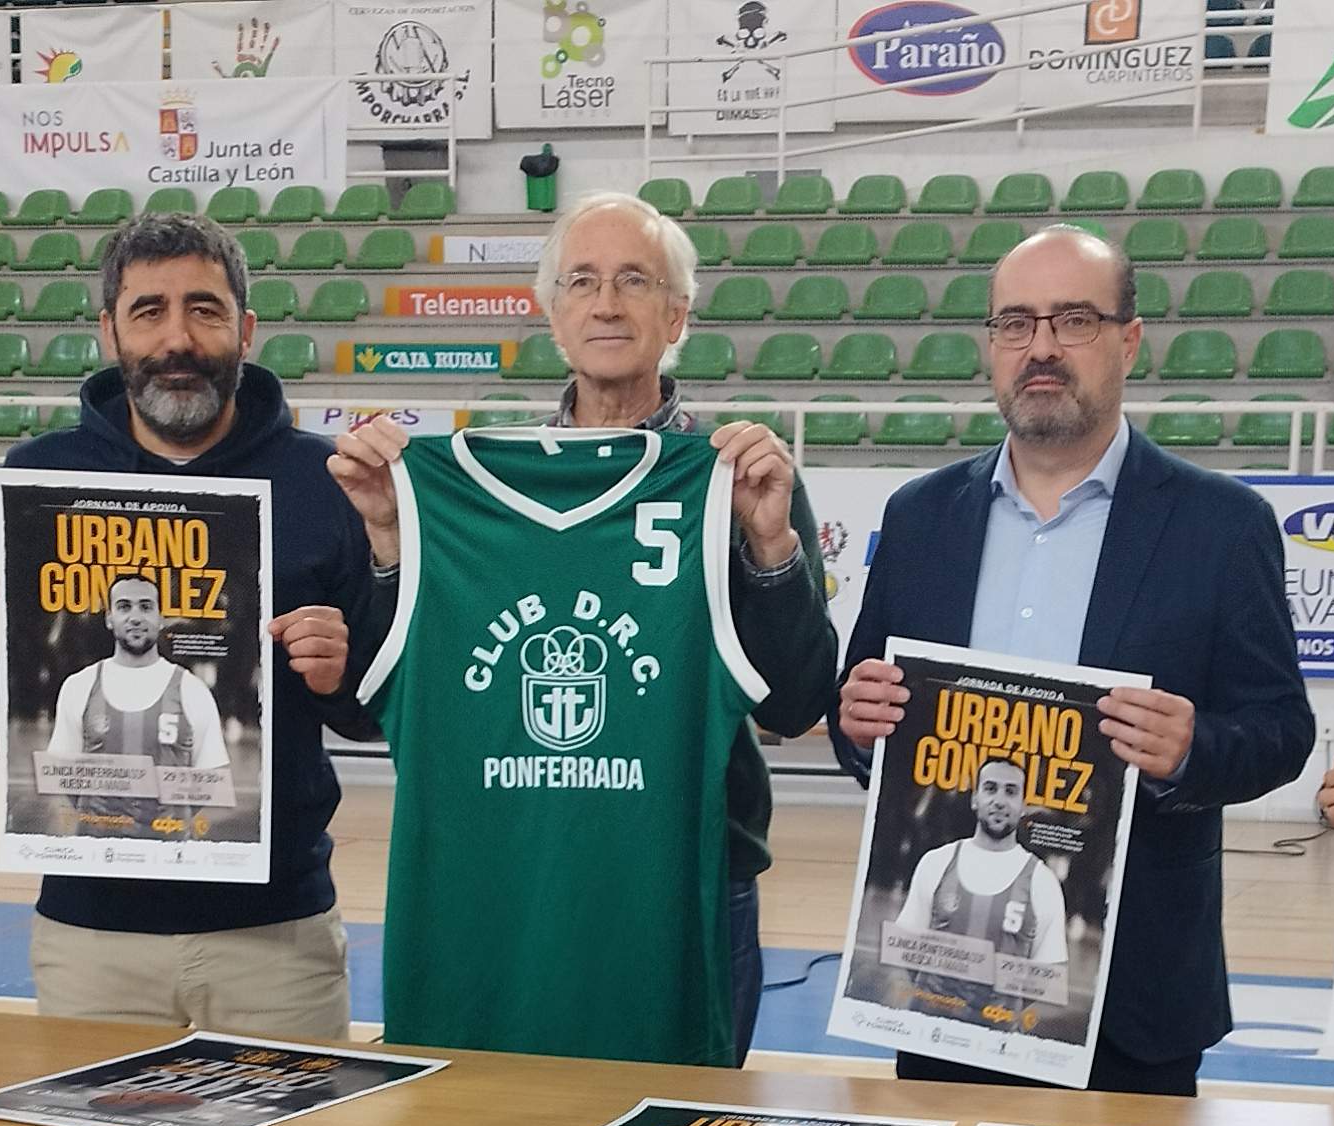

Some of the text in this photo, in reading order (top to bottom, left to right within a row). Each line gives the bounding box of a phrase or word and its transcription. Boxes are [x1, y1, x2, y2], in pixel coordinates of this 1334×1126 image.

[871, 32, 1003, 71] Paraño
[1028, 46, 1193, 71] DOMINGUEZ
[567, 74, 615, 89] Tecno
[1086, 67, 1194, 84] CARPINTEROS
[540, 83, 615, 109] Láser
[22, 110, 63, 128] NOS
[23, 130, 131, 155] IMPULSA
[203, 138, 295, 160] Junta de
[147, 162, 295, 187] Castilla y León
[410, 292, 532, 316] Telenauto
[384, 351, 499, 369] CAJA RURAL
[56, 514, 210, 570] URBANO
[631, 501, 683, 586] 5
[464, 593, 547, 692] CLUB
[157, 713, 180, 746] 5
[935, 688, 1084, 760] URBANO
[482, 755, 645, 792] PONFERRADA
[1003, 900, 1027, 935] 5
